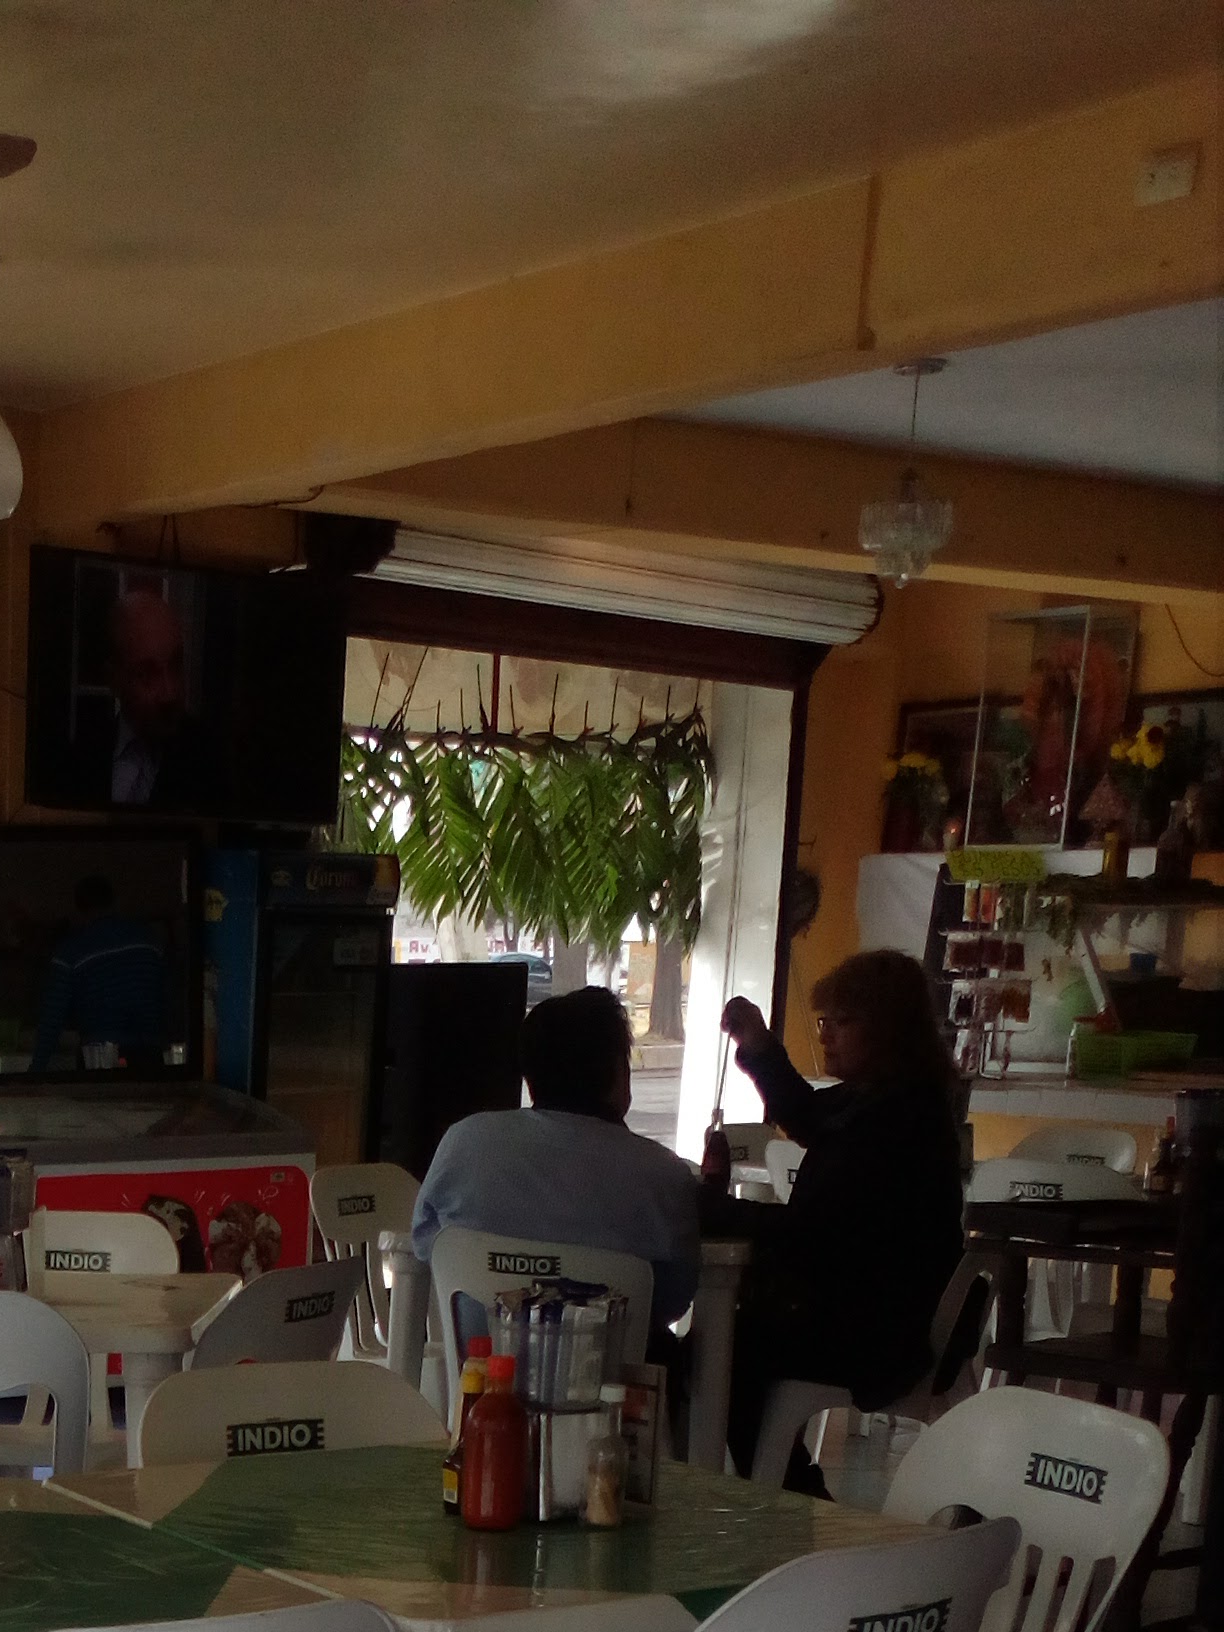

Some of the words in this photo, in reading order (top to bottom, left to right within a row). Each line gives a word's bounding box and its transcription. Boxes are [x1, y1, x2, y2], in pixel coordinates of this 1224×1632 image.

[50, 1252, 103, 1271] INDIO
[496, 1255, 551, 1273] INDIO
[292, 1297, 331, 1319] INDIO
[238, 1423, 312, 1452] INDIO
[1036, 1458, 1098, 1497] INDIO
